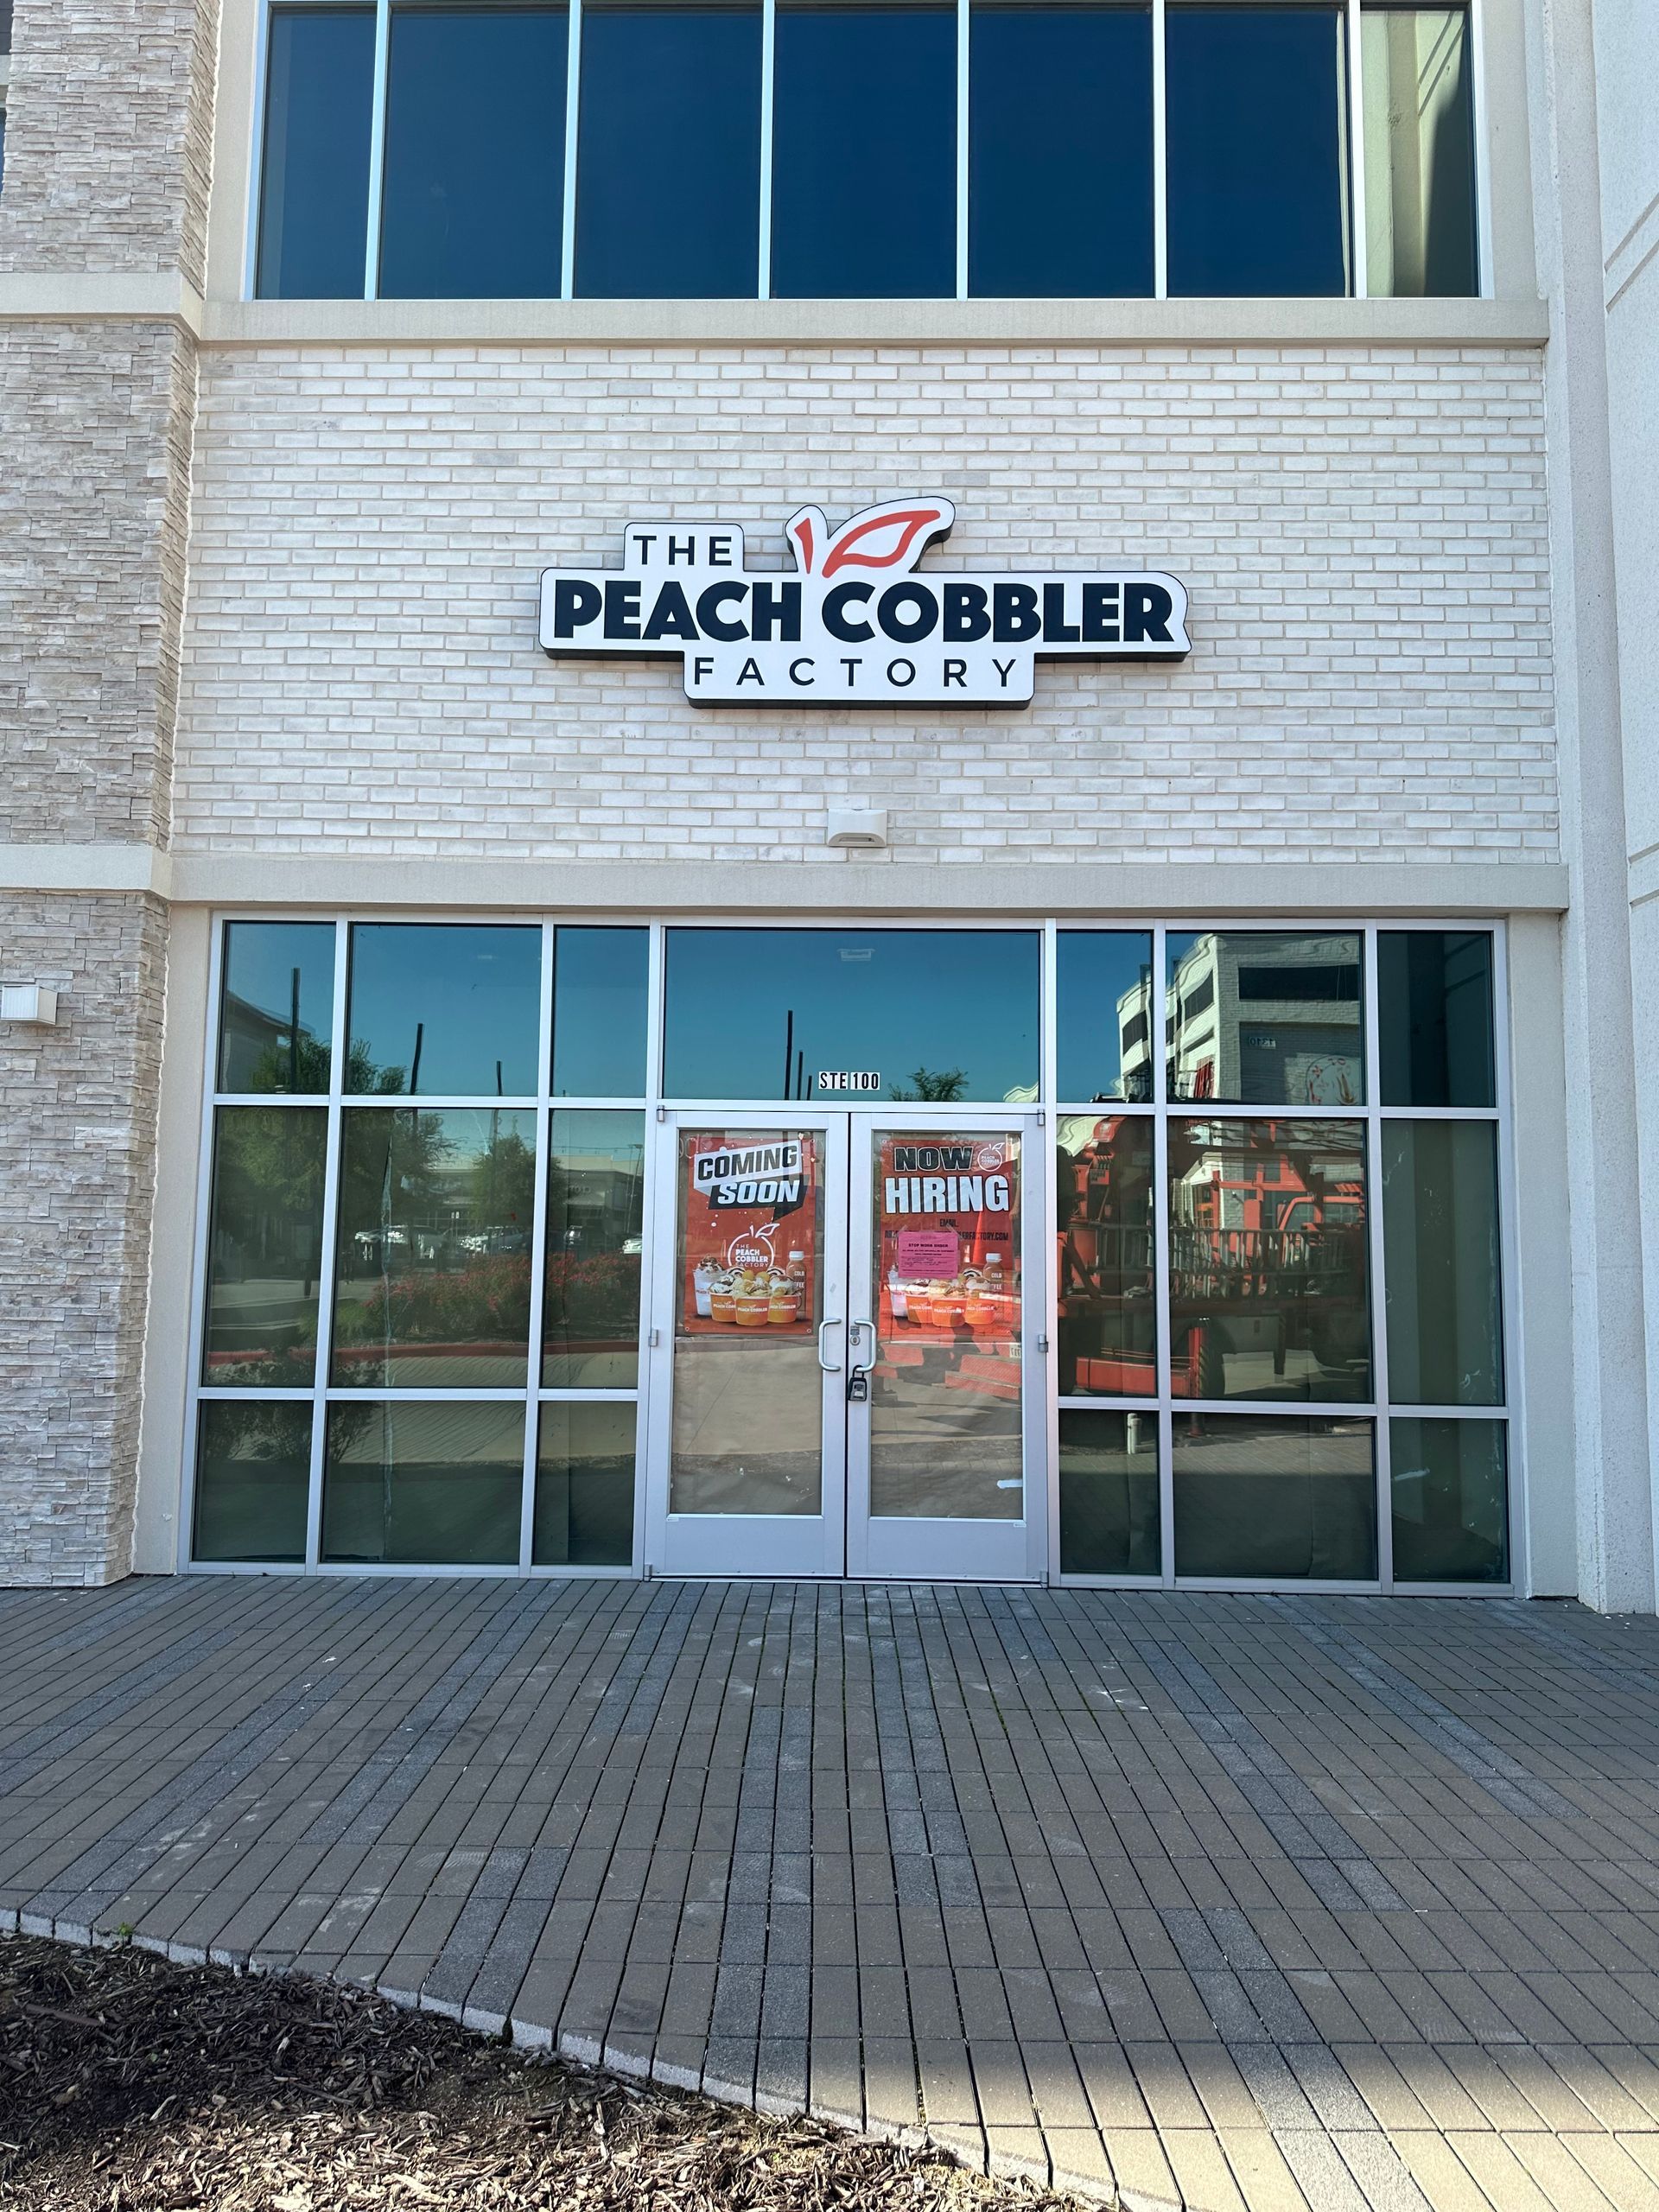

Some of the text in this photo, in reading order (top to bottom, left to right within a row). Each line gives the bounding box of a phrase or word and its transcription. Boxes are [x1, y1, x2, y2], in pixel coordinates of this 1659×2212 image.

[632, 535, 734, 566] THE
[554, 579, 1175, 644] PEACH COBBLER
[695, 657, 1017, 688] FACTORY
[820, 1072, 879, 1089] STE 100
[697, 1145, 798, 1180] COMING
[894, 1147, 974, 1172] NOW
[717, 1179, 800, 1205] SOON
[885, 1174, 1009, 1214] HIRING
